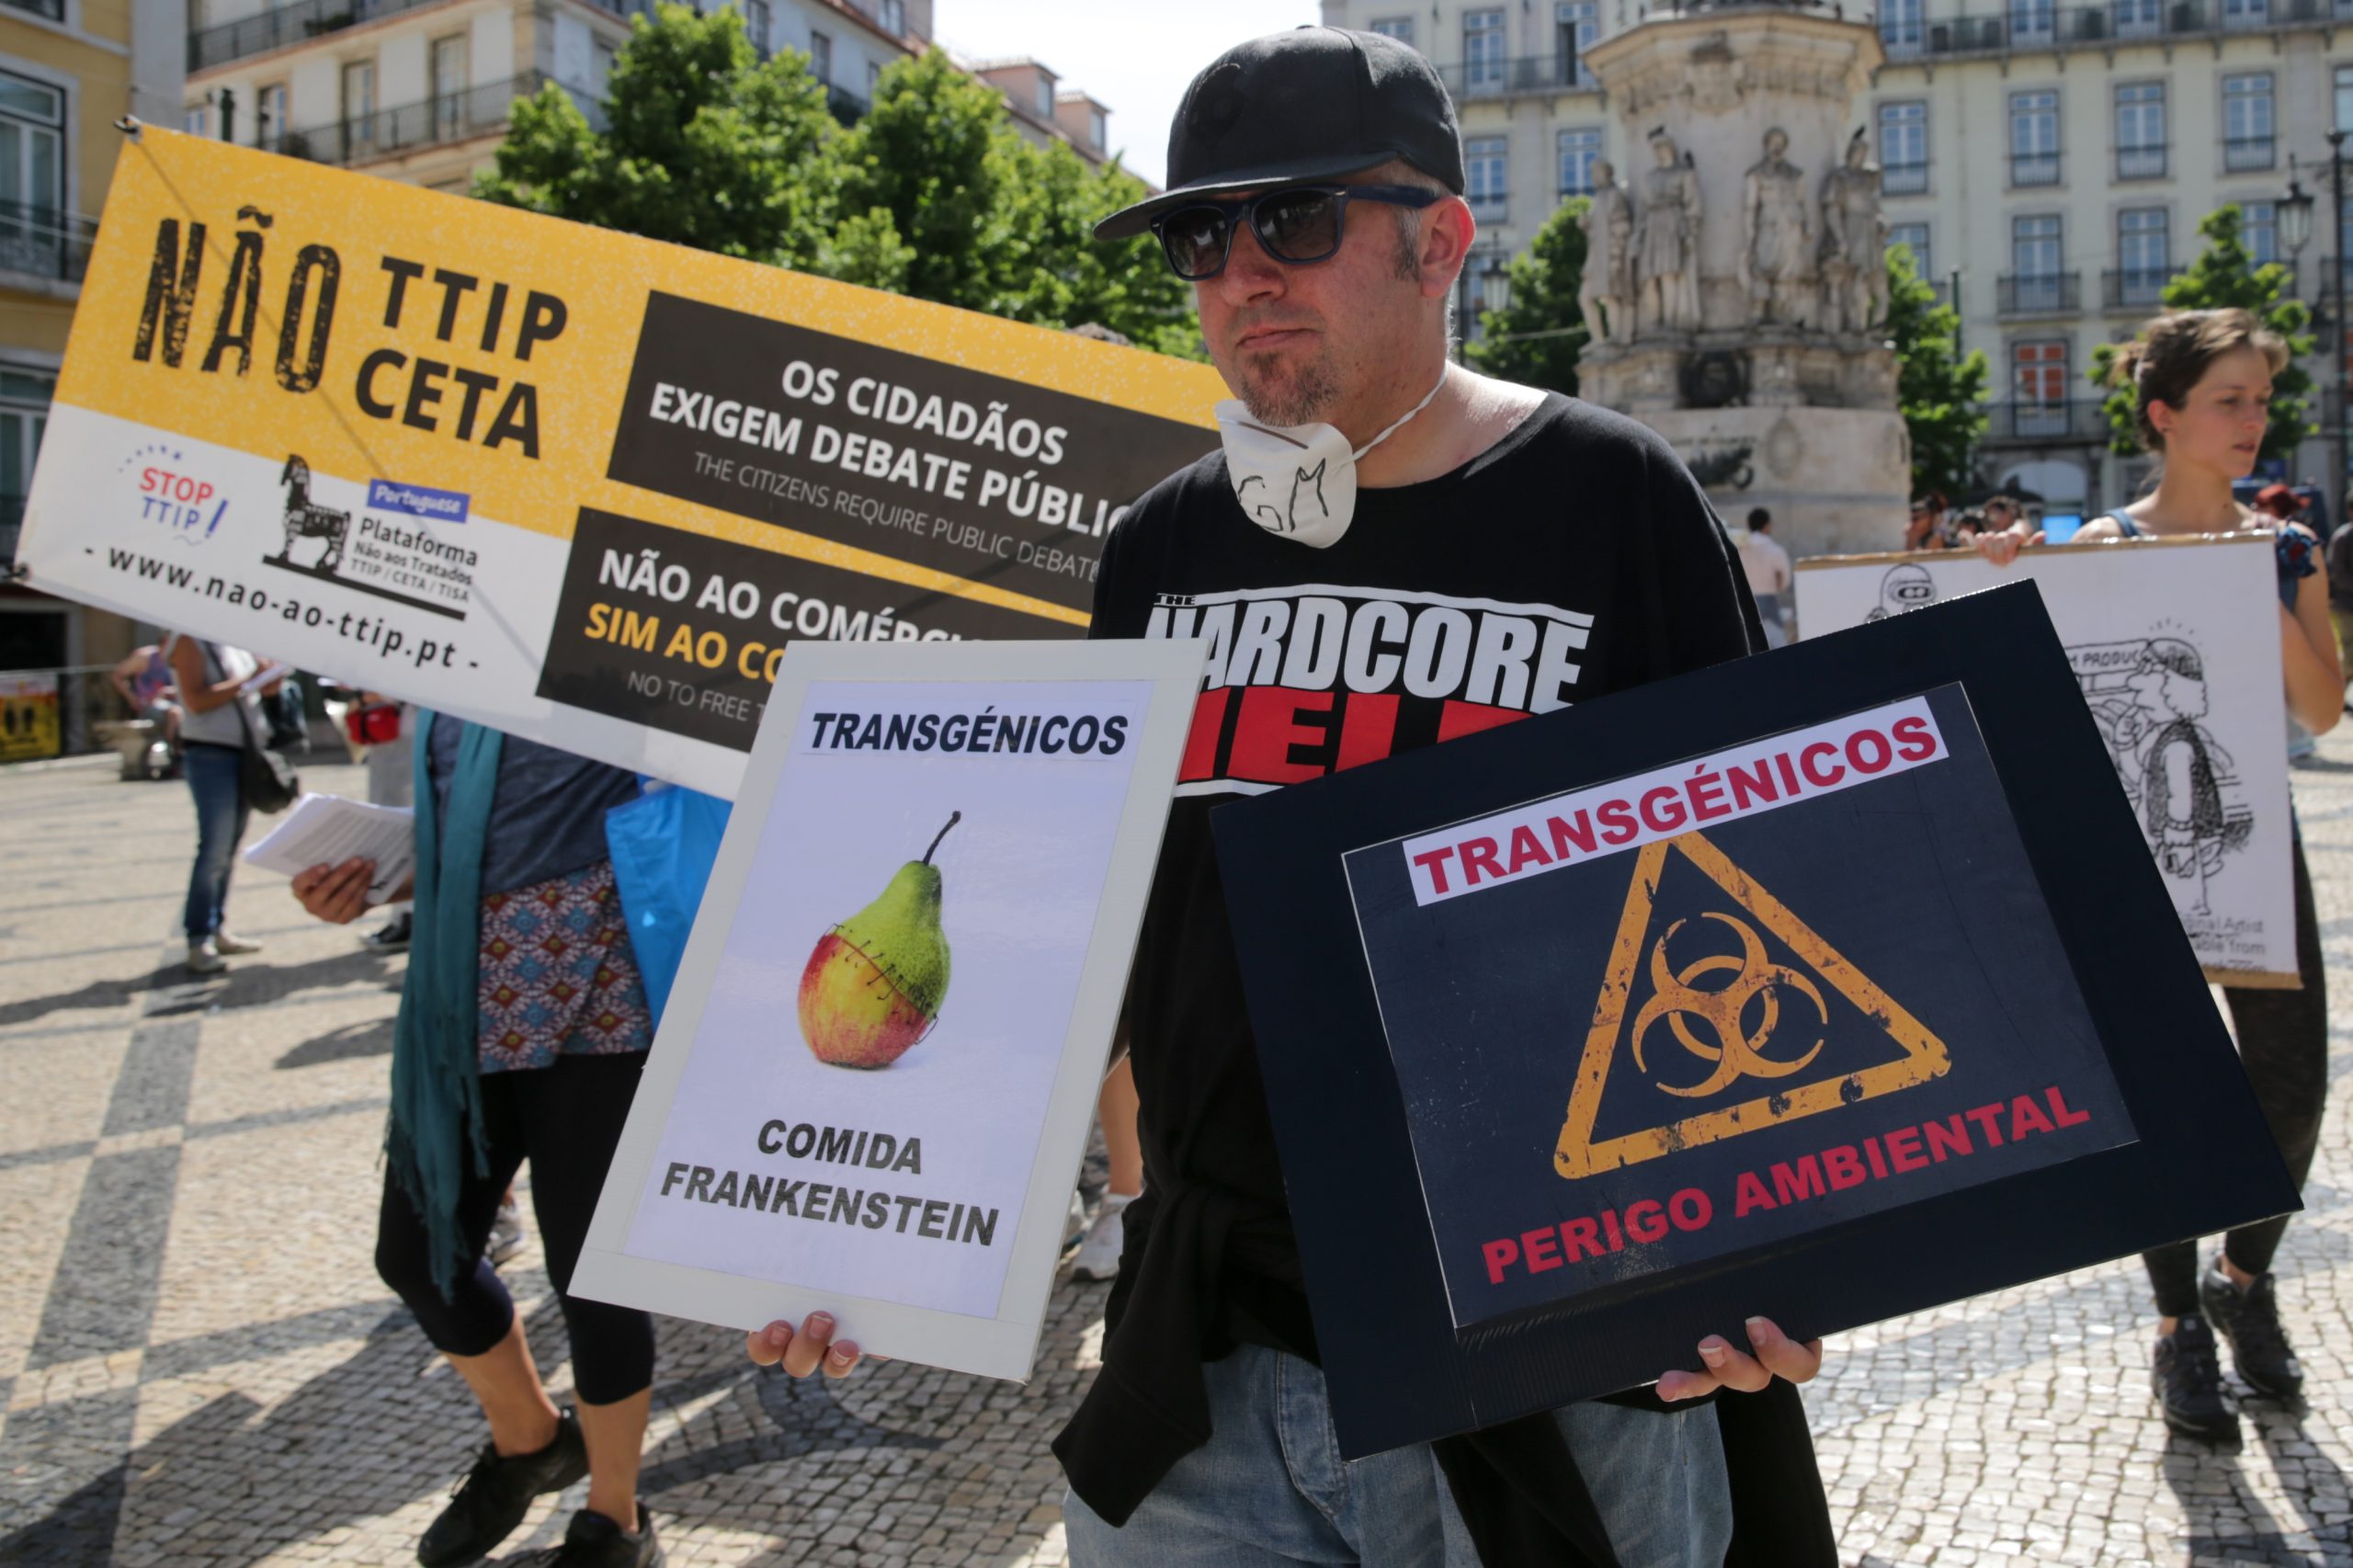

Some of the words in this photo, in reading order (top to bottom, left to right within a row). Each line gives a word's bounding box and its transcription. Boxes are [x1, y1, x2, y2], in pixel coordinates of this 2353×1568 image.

[132, 204, 341, 394] NÃO
[381, 256, 568, 362] TTIP
[355, 348, 540, 460] CETA
[649, 381, 802, 455] EXIGEM
[810, 425, 972, 500] DEBATE
[782, 360, 840, 406] OS
[847, 377, 1068, 465] CIDADÃOS
[139, 467, 215, 505] STOP
[374, 484, 461, 513] Portuguese
[695, 451, 735, 482] THE
[738, 465, 830, 507] CITIZENS
[834, 491, 928, 535] REQUIRE
[932, 517, 1014, 558] PUBLIC
[351, 558, 381, 575] TTIP
[392, 570, 426, 590] CETA
[438, 583, 469, 602] TISA
[354, 541, 381, 559] Não
[384, 552, 406, 567] aos
[411, 557, 472, 585] Tratados
[359, 517, 478, 566] Plataforma
[109, 548, 456, 668] www.nao-ao-ttip.pt
[599, 549, 690, 602] NÃO
[696, 574, 761, 619] AO
[1156, 594, 1197, 606] THE
[584, 603, 660, 653] SIM
[664, 624, 728, 668] AO
[738, 642, 786, 684] CO
[628, 671, 662, 698] NO
[667, 680, 696, 706] TO
[699, 689, 751, 722] FREE
[812, 706, 1129, 755] TRANSGÉNICOS
[1414, 716, 1937, 895] TRANSGÉNICOS
[757, 1119, 922, 1175] COMIDA
[1482, 1187, 1712, 1284] PERIGO
[1734, 1085, 2091, 1218] AMBIENTAL
[660, 1161, 999, 1246] FRANKENSTEIN
